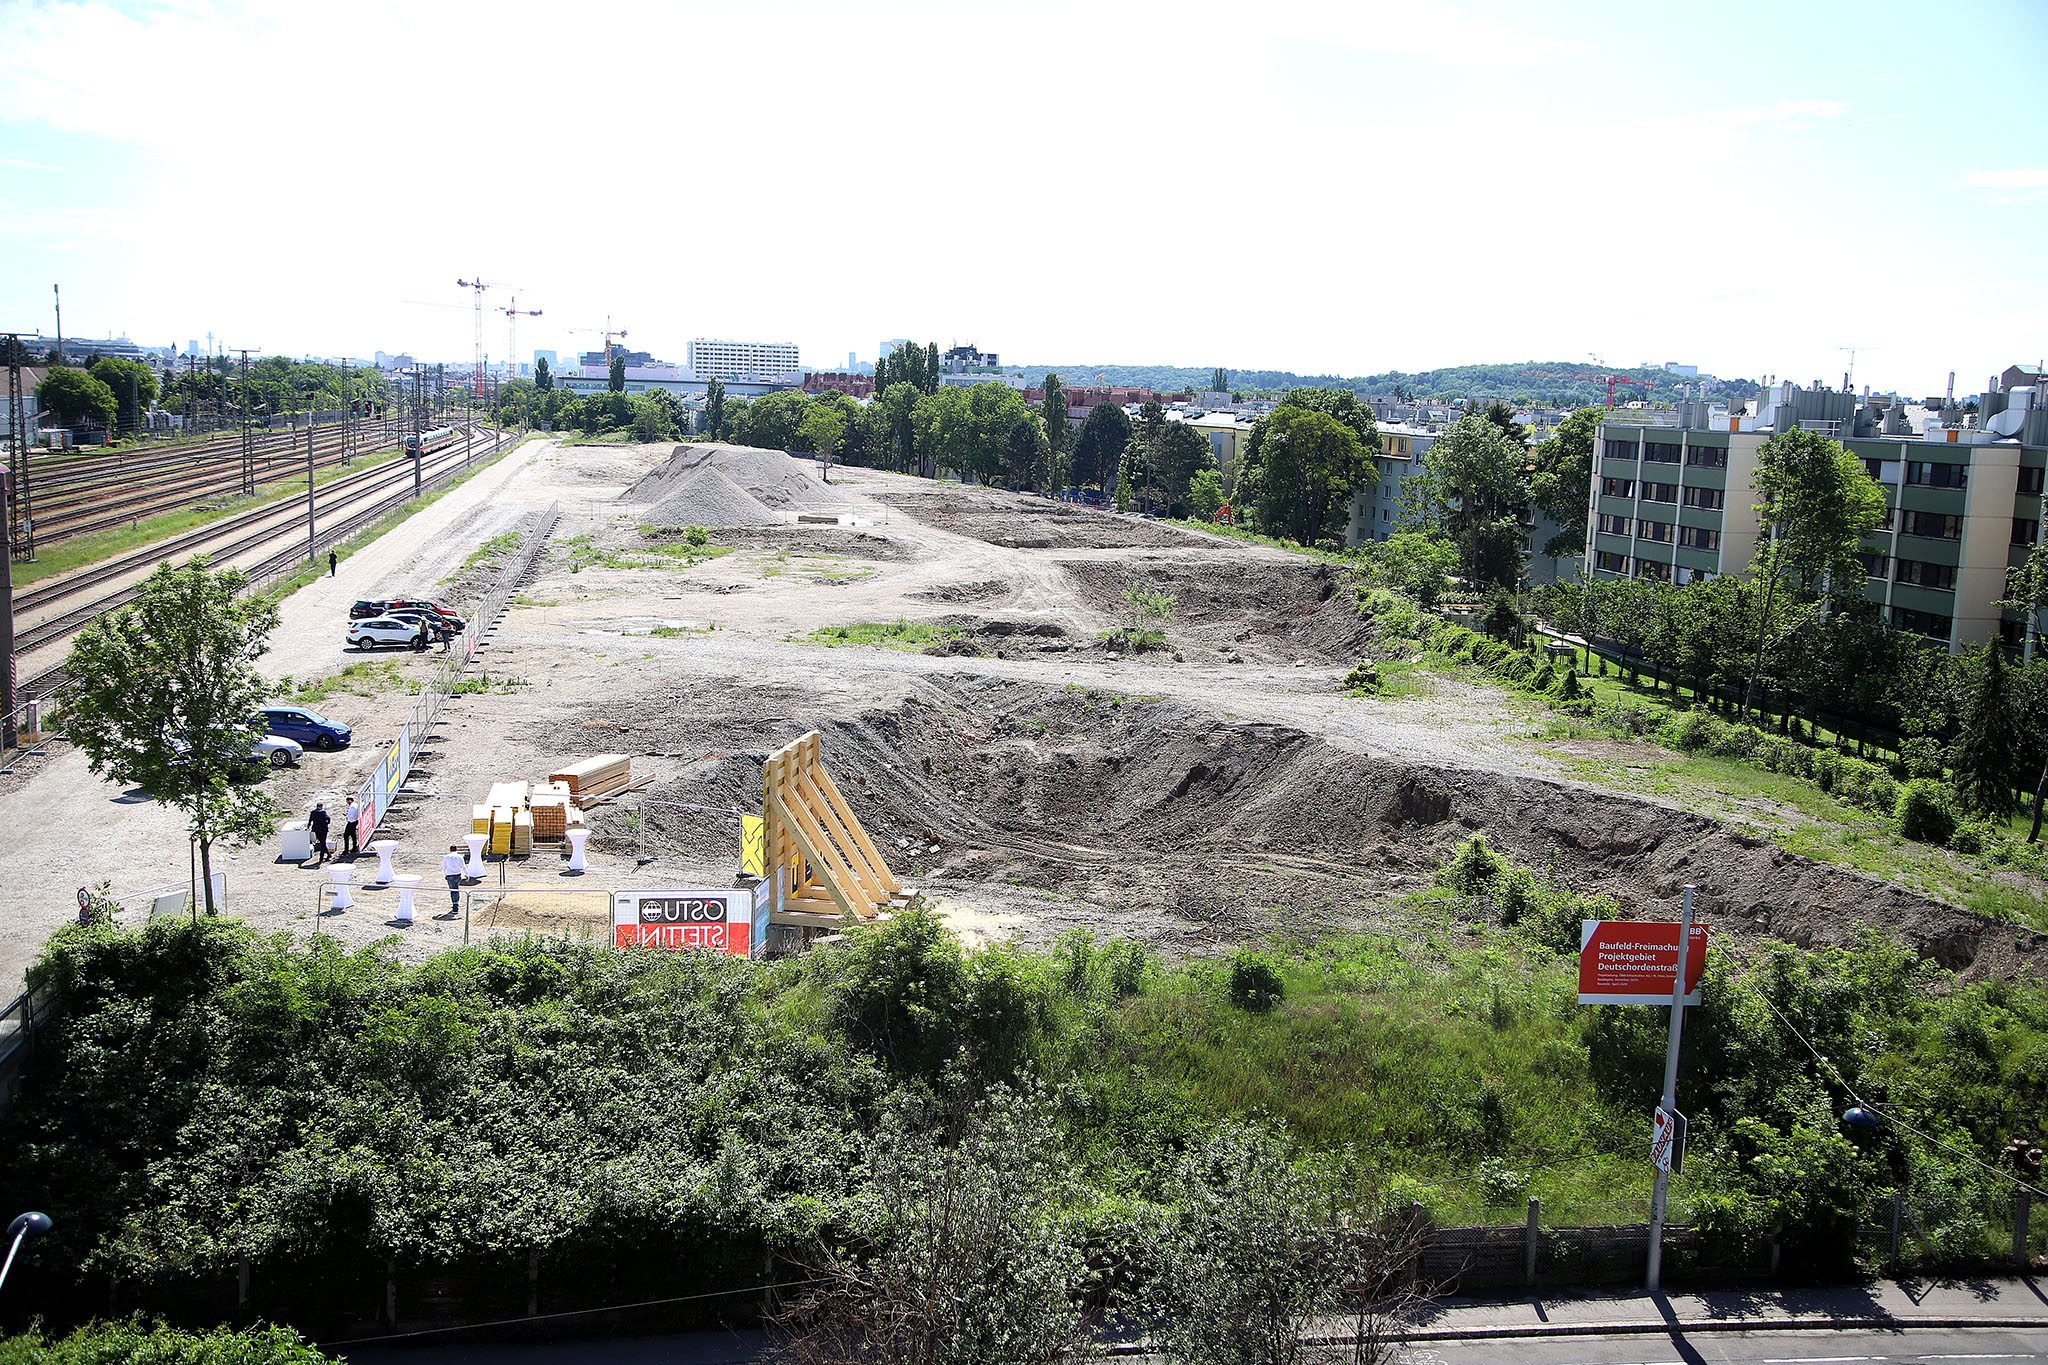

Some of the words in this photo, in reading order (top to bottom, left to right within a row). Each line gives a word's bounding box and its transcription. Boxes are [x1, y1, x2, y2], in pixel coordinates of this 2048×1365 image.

[1689, 927, 1702, 935] BB
[1599, 941, 1689, 952] Baufeld-Freimachu
[1598, 952, 1656, 962] Projektgebiet
